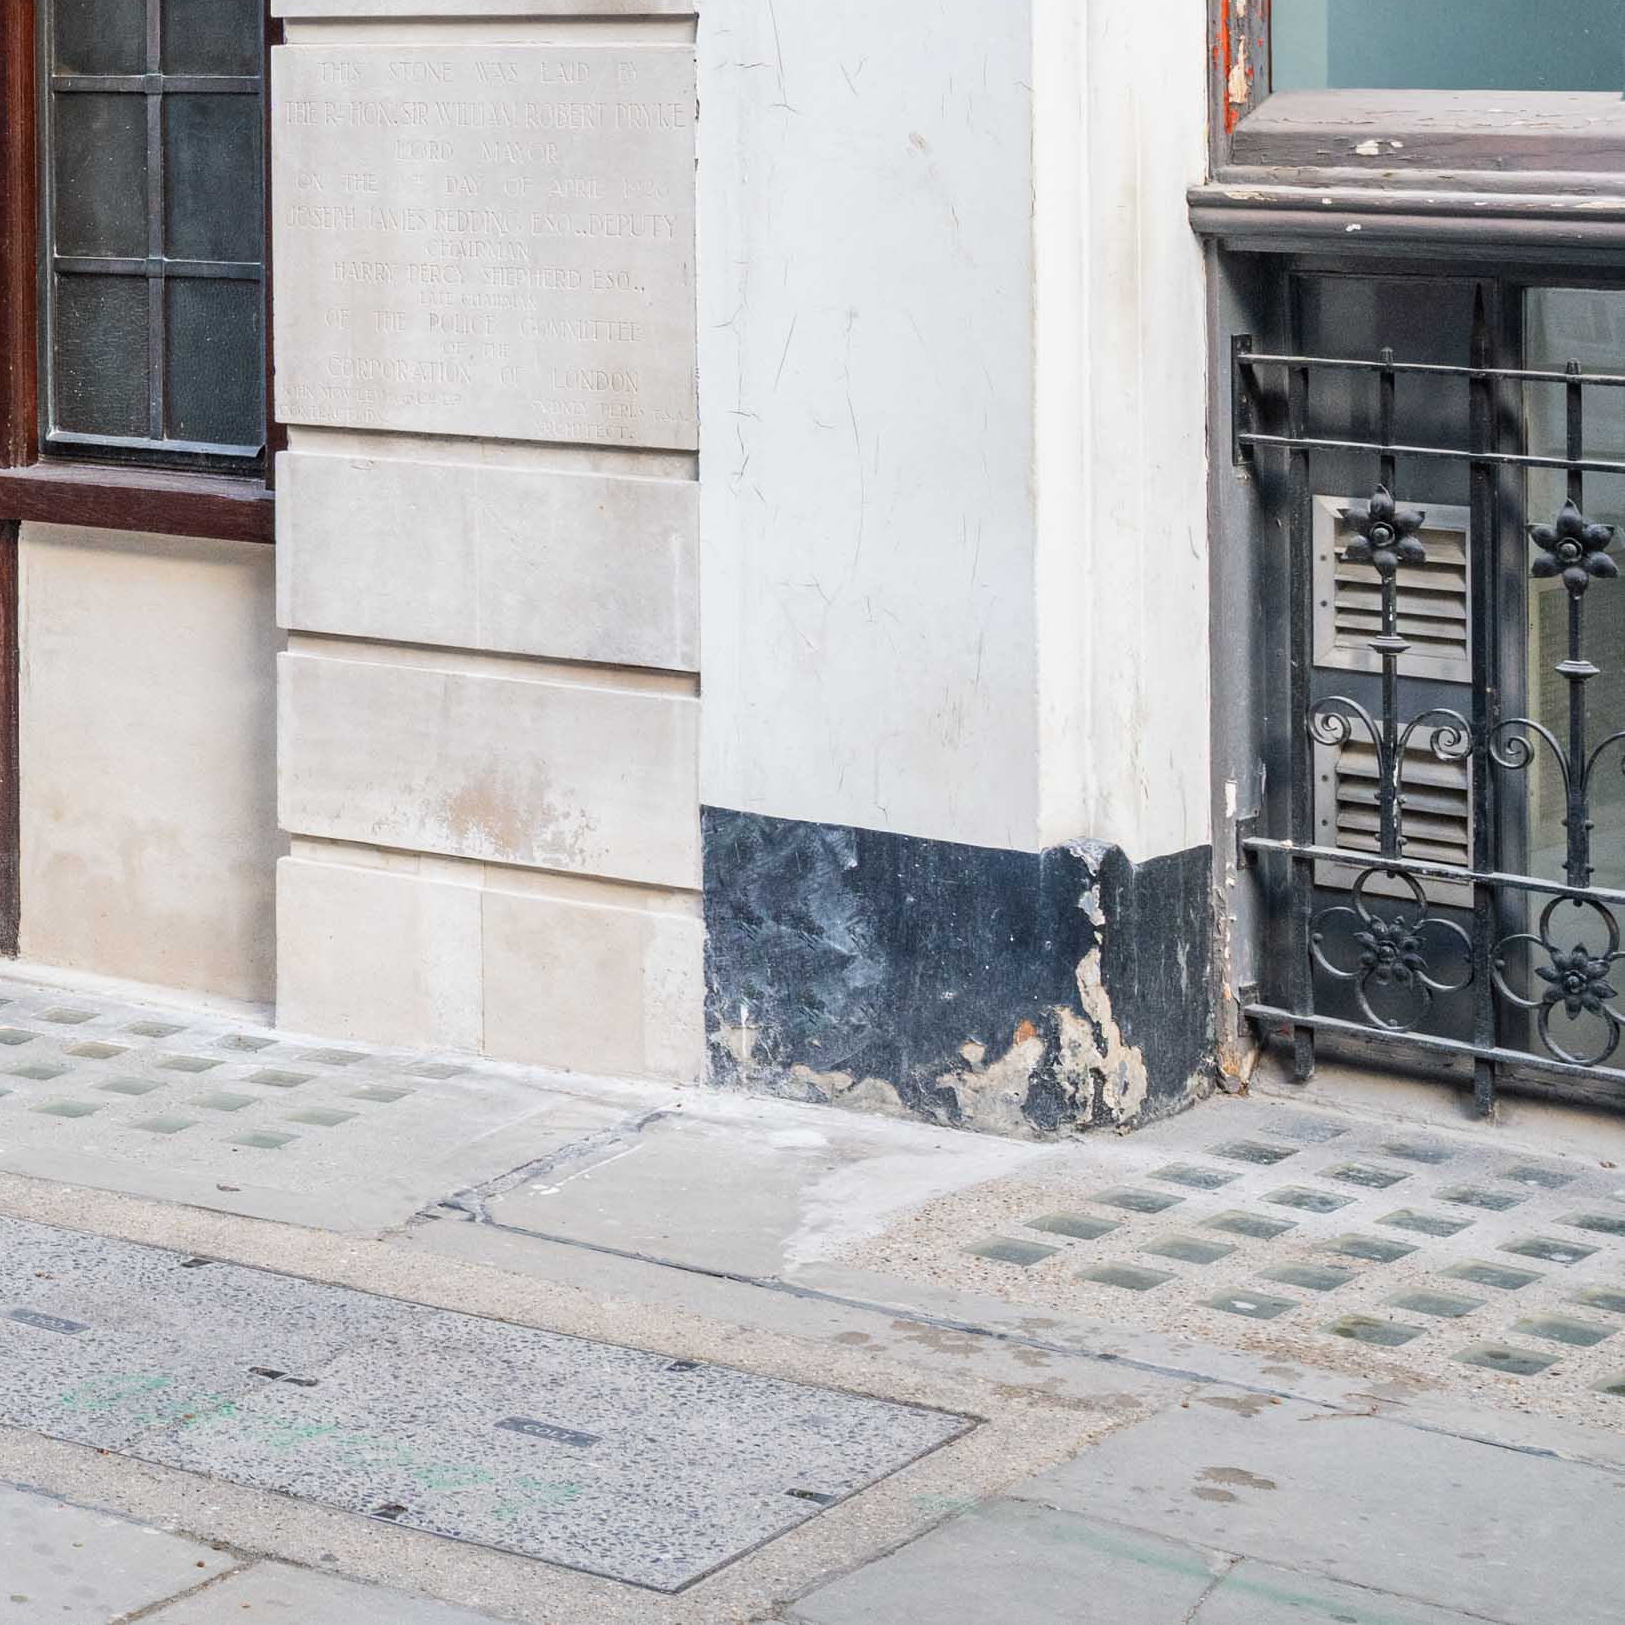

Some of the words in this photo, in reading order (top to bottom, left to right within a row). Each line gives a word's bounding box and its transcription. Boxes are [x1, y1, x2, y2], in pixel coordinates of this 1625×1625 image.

[318, 60, 363, 84] THIS
[387, 60, 454, 84] STONE
[475, 61, 519, 85] WAS
[540, 61, 591, 85] LAID
[617, 60, 640, 85] BY
[284, 100, 318, 126] THE
[400, 101, 429, 126] SIR
[434, 101, 512, 127] WILLIAM
[524, 101, 606, 129] ROBERT
[613, 101, 687, 129] PRYKE
[395, 140, 455, 163] LORD
[479, 140, 558, 165] MAYOR
[296, 173, 324, 191] ON
[340, 173, 379, 194] THE
[443, 174, 480, 196] DAY
[502, 175, 534, 199] OF
[548, 175, 605, 200] APRIL
[285, 205, 357, 229] JOSEPH
[364, 205, 428, 231] JAMES
[588, 212, 677, 240] DEPUTY
[423, 239, 531, 263] CHAIRMAN
[333, 260, 395, 283] HARRY
[406, 262, 466, 286] PERCY
[482, 266, 582, 291] SHEPHERD
[420, 291, 455, 307] LATE
[325, 308, 351, 329] OF
[371, 310, 407, 333] THE
[428, 311, 495, 336] POLICE
[518, 317, 643, 344] COMMITTEE
[442, 341, 466, 358] OF
[480, 341, 511, 359] THE
[324, 355, 473, 384] CORPORATION
[499, 365, 524, 387] OF
[551, 367, 640, 394] LONDON
